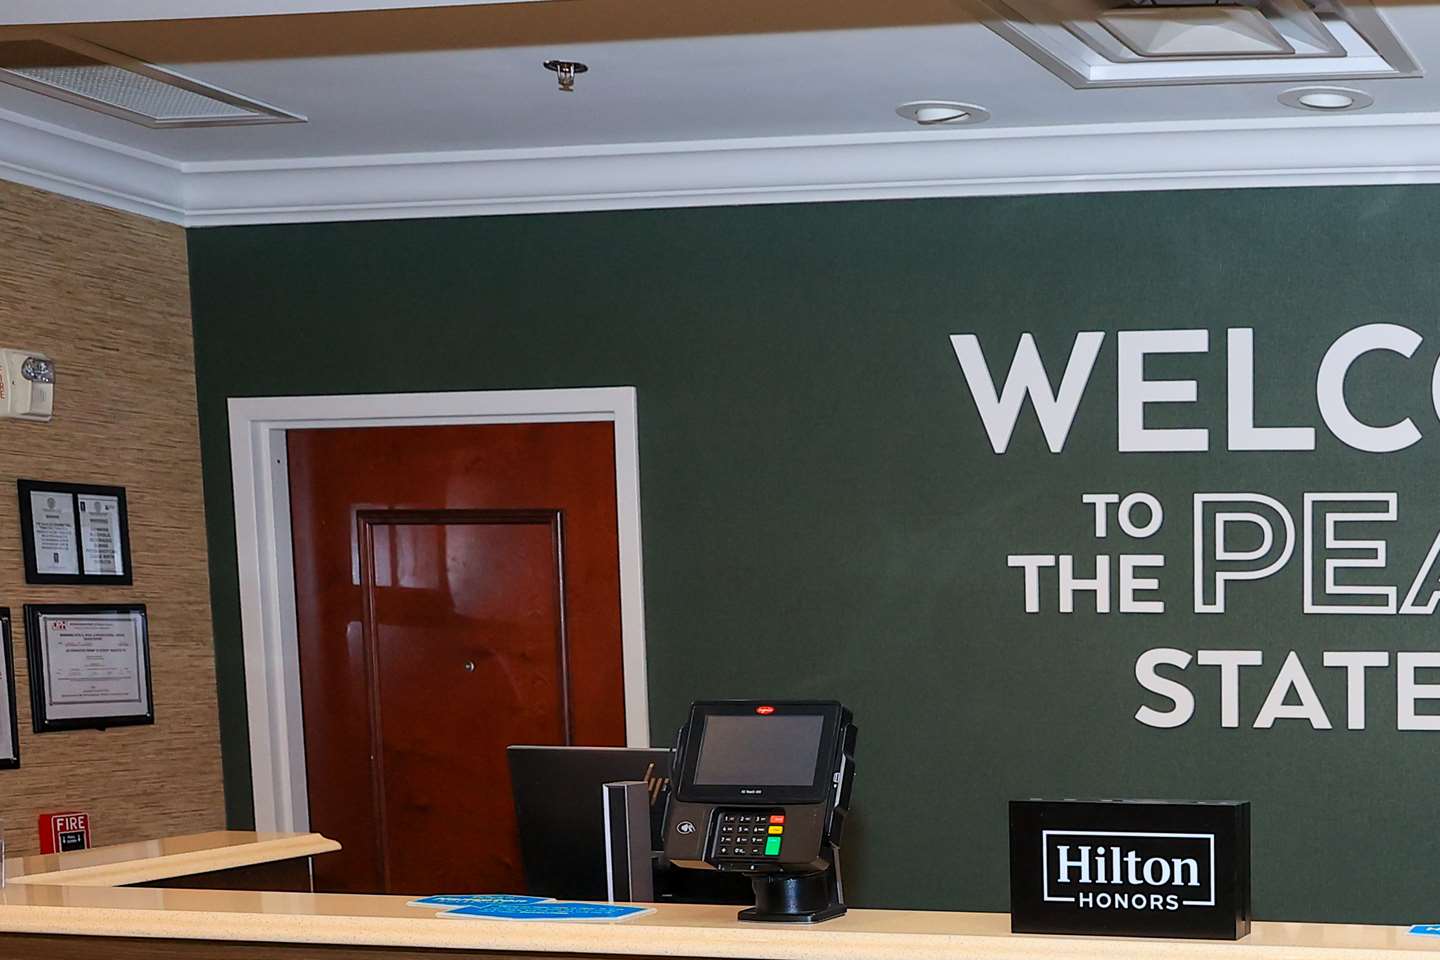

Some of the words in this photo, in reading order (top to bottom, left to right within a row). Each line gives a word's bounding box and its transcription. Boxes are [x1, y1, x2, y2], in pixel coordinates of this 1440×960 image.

[1082, 492, 1164, 538] TO
[1007, 554, 1165, 613] THE
[56, 815, 86, 832] FIRE
[1056, 845, 1201, 887] Hilton
[1079, 892, 1179, 911] HONORS
